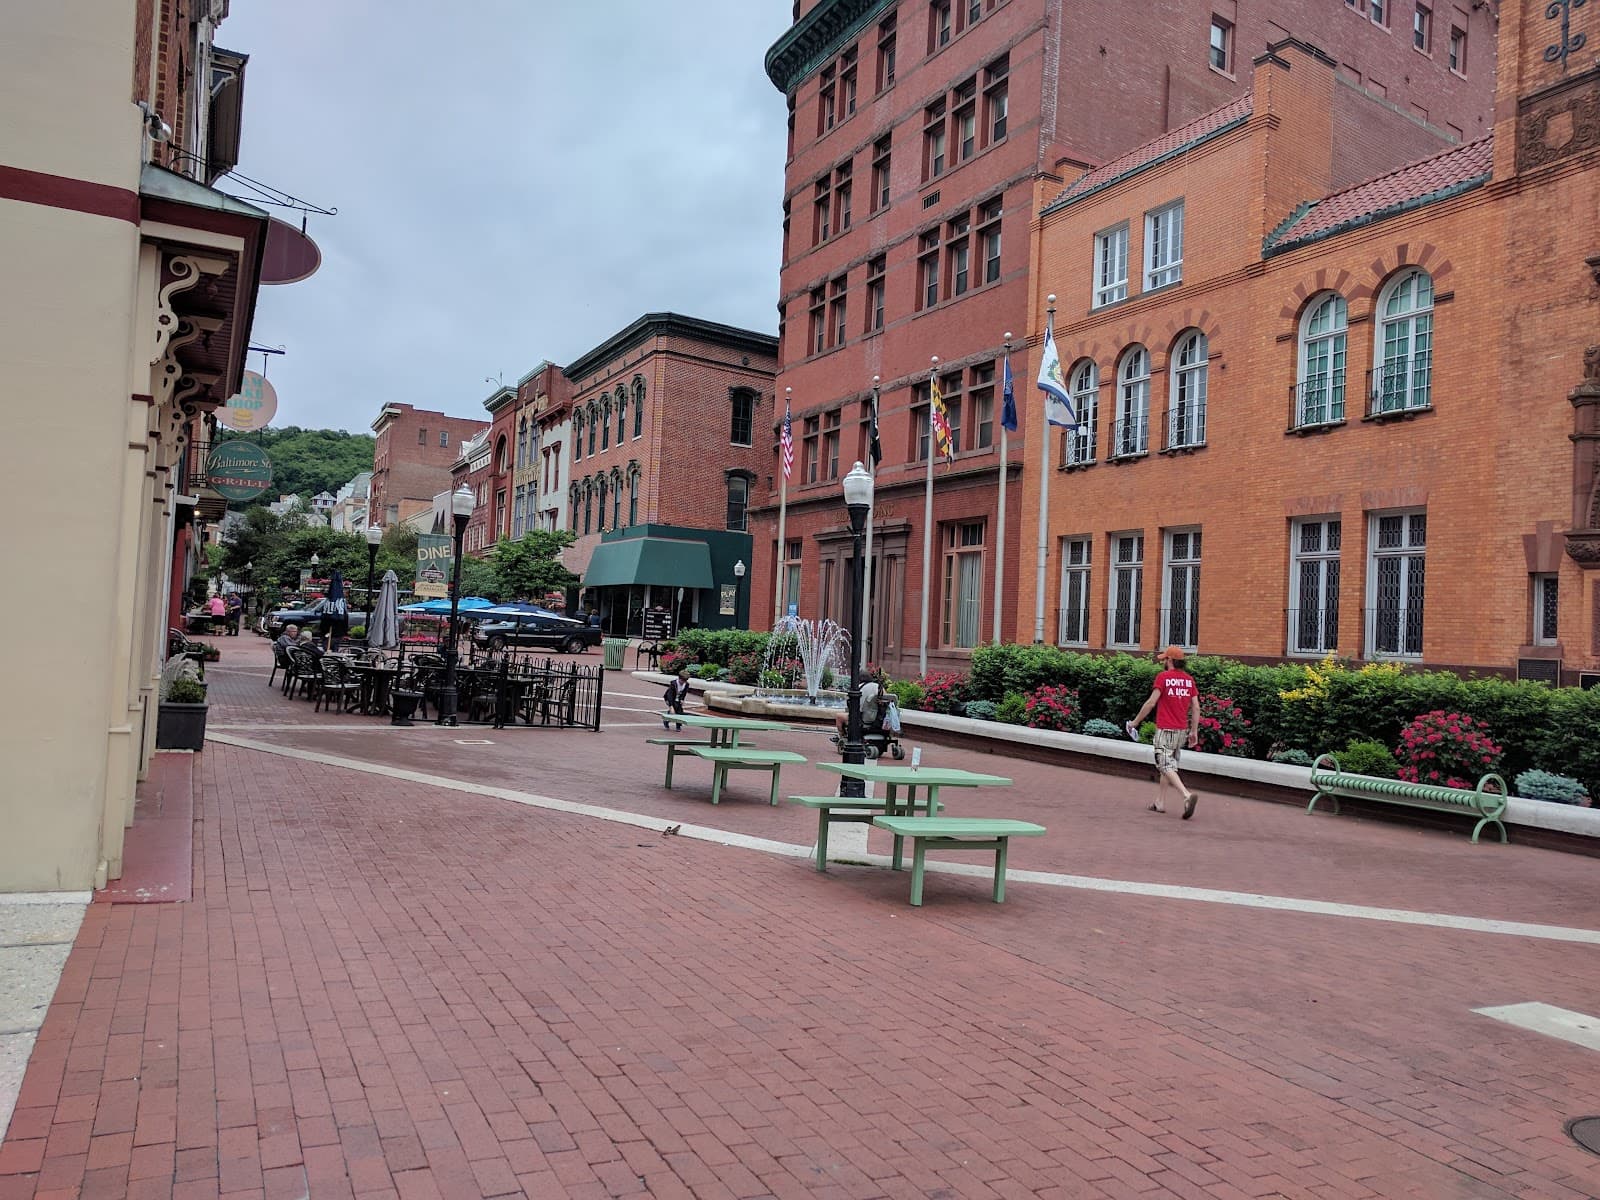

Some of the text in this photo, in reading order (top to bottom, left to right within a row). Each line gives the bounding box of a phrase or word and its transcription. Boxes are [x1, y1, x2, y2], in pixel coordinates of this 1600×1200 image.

[207, 455, 258, 470] Baltimore
[417, 545, 451, 561] DINE
[1168, 688, 1175, 696] A
